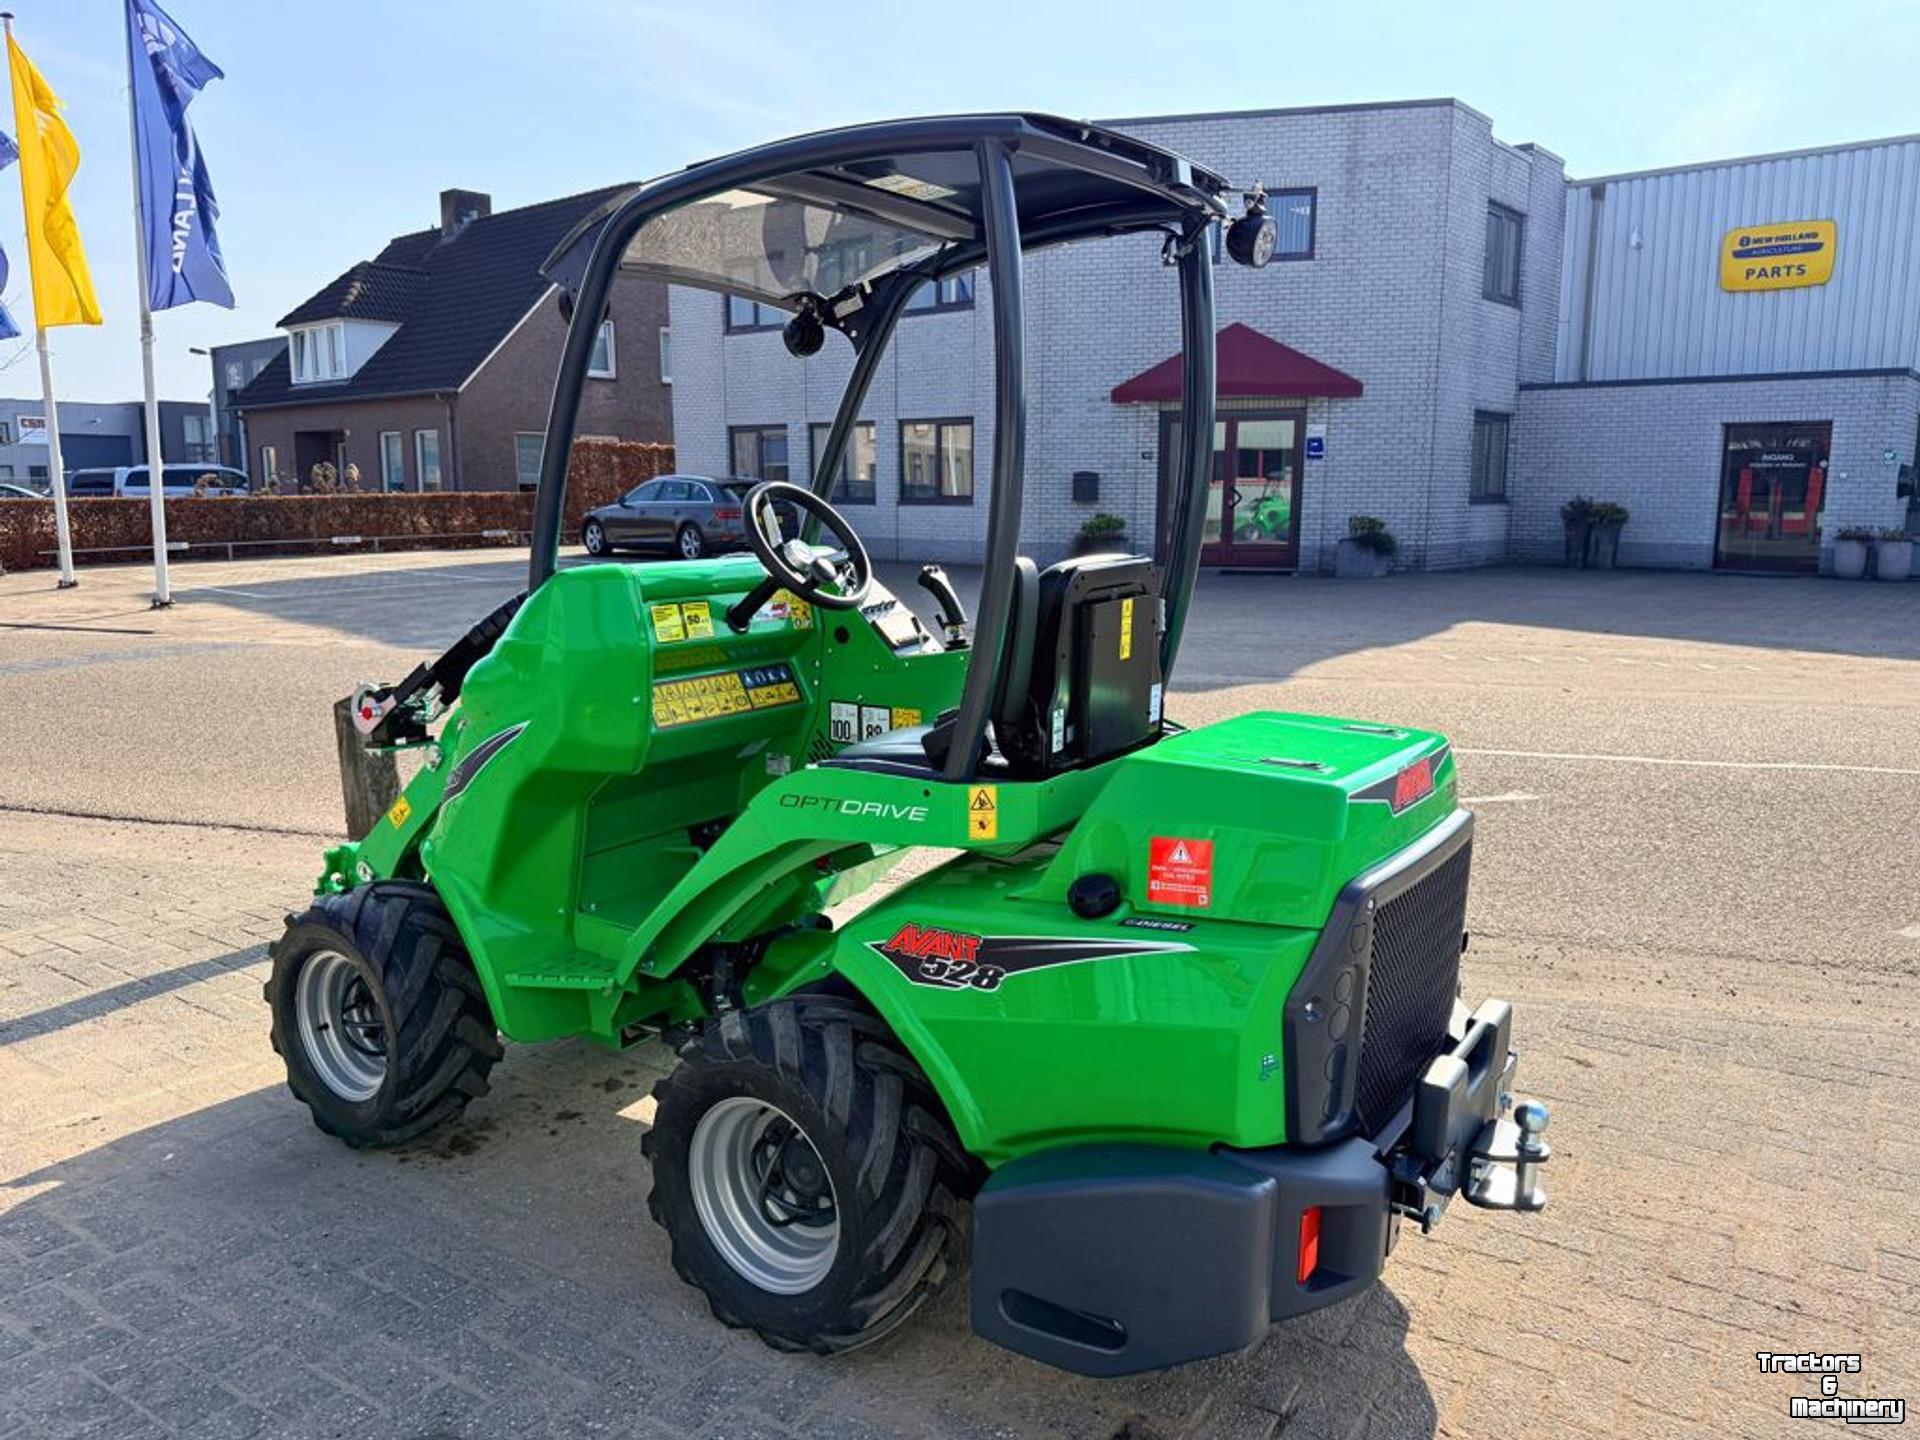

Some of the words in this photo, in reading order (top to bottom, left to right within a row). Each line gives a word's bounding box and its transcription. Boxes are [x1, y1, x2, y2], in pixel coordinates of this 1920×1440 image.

[1745, 264, 1807, 280] PARTS
[832, 719, 851, 740] 100
[779, 793, 929, 822] OPTIDRIVE
[881, 921, 983, 961] AVANT
[919, 953, 1006, 992] 528
